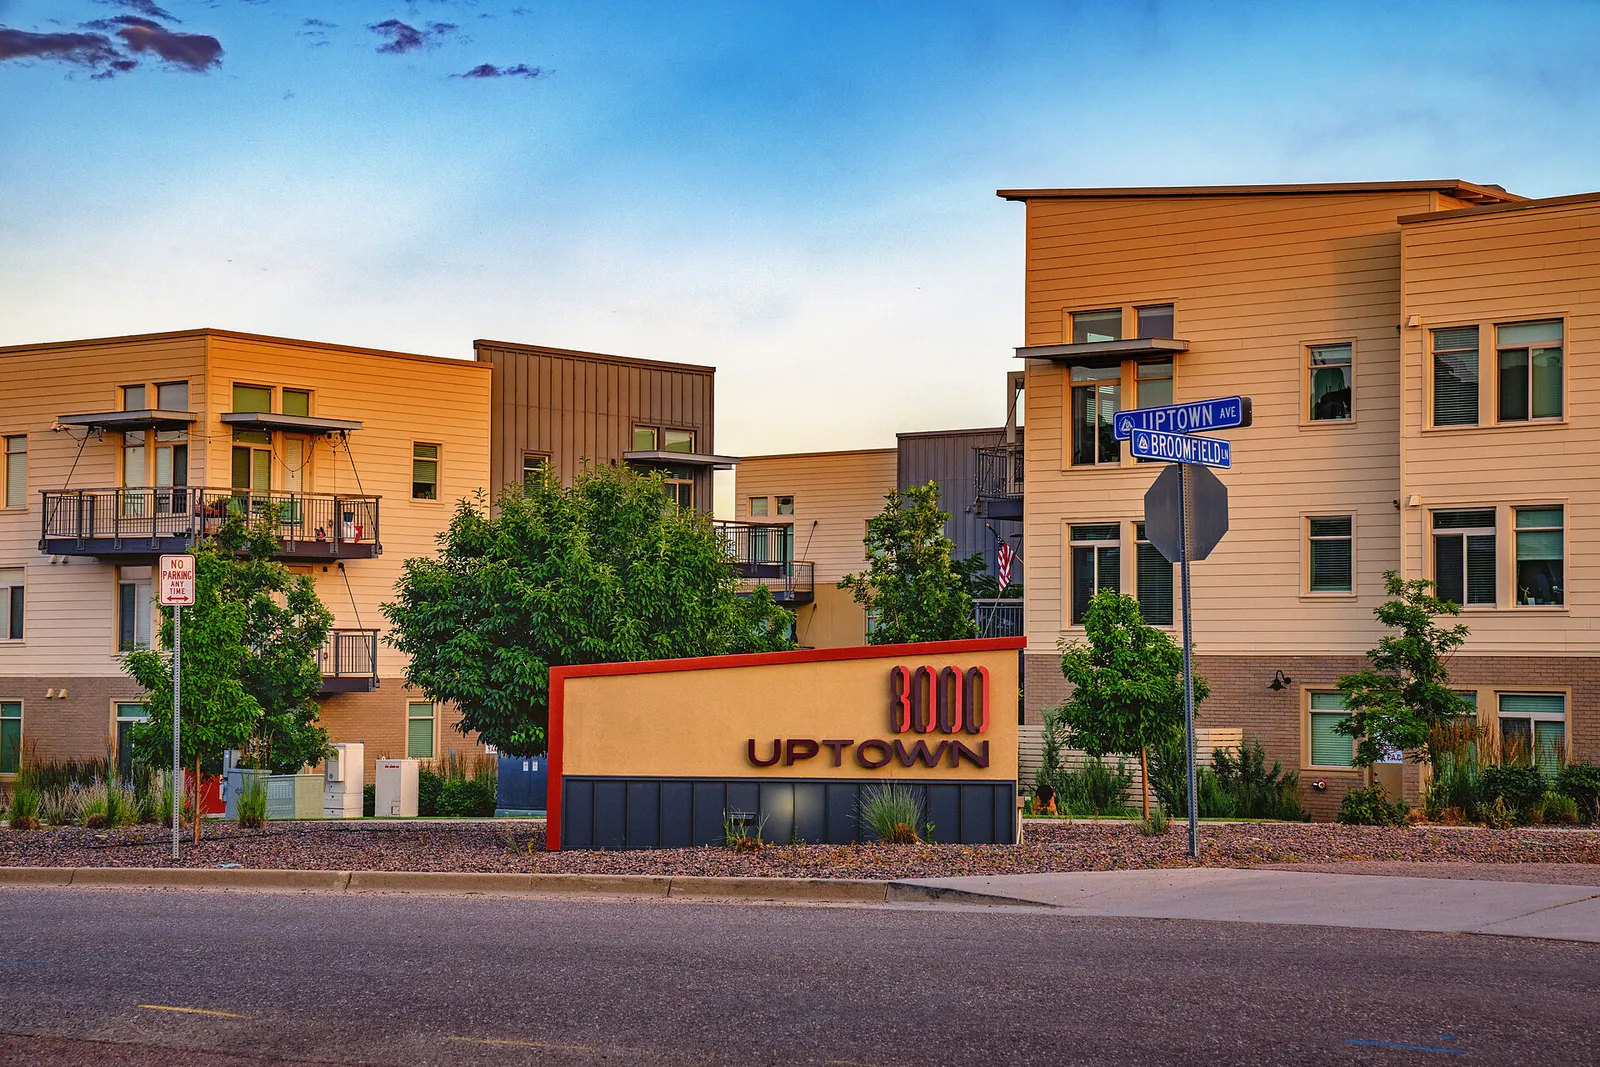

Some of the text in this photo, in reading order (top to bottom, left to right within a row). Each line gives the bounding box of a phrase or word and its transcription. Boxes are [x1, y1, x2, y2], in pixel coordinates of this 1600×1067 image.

[1142, 404, 1237, 431] UPTOWN AVE
[1151, 434, 1229, 463] BROOMFIELD LN
[162, 570, 192, 580] PARKING
[170, 559, 184, 569] NO
[169, 587, 186, 595] TIME
[890, 665, 990, 734] 8000
[747, 738, 990, 769] UPTOWN
